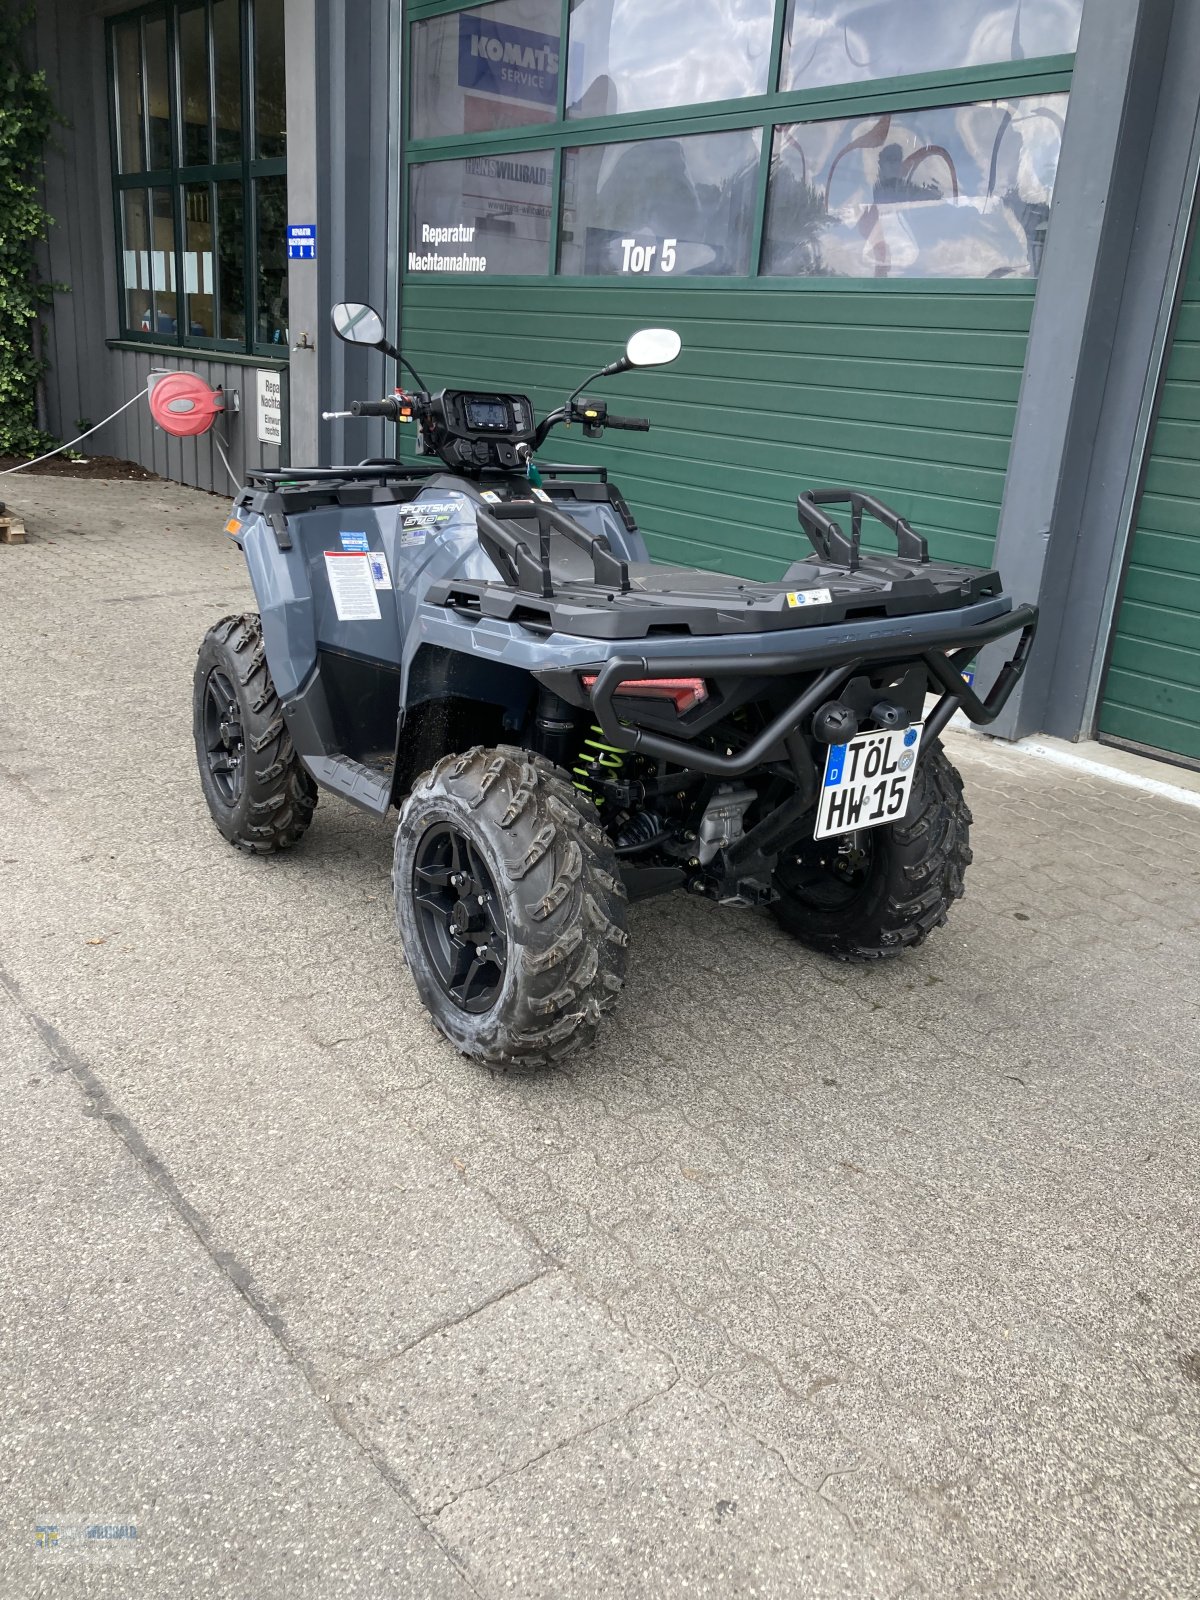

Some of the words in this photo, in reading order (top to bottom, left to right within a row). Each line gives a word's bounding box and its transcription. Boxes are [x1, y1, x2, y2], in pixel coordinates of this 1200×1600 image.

[501, 67, 545, 89] SERVICE
[422, 223, 475, 247] Reparatur
[408, 252, 487, 272] Nachtannahme
[621, 238, 657, 272] Tor
[660, 238, 677, 272] 5
[399, 503, 464, 515] SPORTSMAN
[848, 736, 898, 782] TÖL
[830, 768, 838, 780] D
[869, 776, 907, 820] 15
